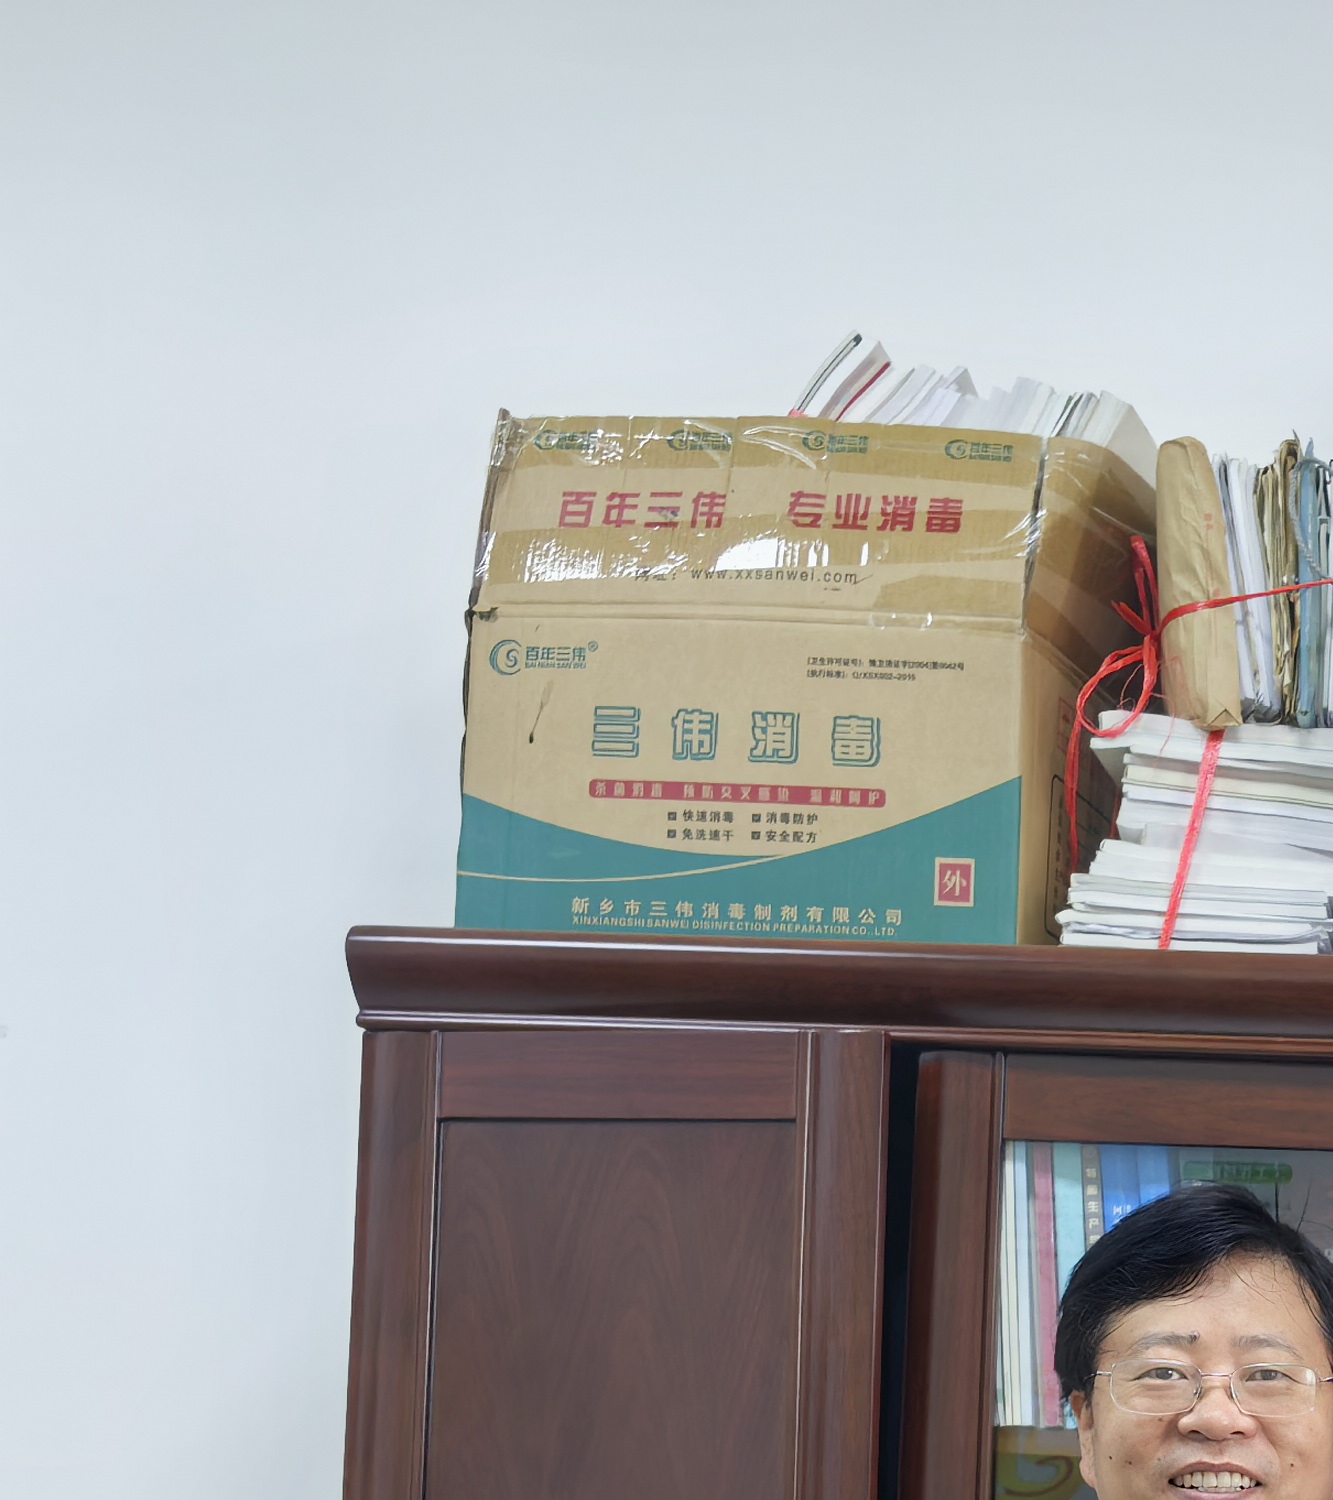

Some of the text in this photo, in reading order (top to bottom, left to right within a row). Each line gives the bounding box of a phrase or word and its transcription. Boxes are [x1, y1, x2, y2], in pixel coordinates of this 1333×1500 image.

[558, 490, 964, 534] 百年三伟 专业消毒
[691, 568, 858, 584] www.xxsanwei.com
[525, 646, 587, 662] 百年三伟
[592, 706, 881, 767] 三伟消毒
[682, 809, 819, 826] 快速消毒 消毒防护
[682, 828, 818, 844] 免洗速干 安全配方
[942, 869, 968, 897] 外
[571, 896, 903, 926] 新乡市三伟消毒制剂有限公司
[692, 919, 771, 932] DISINFECTION
[773, 922, 850, 934] PREPARATION
